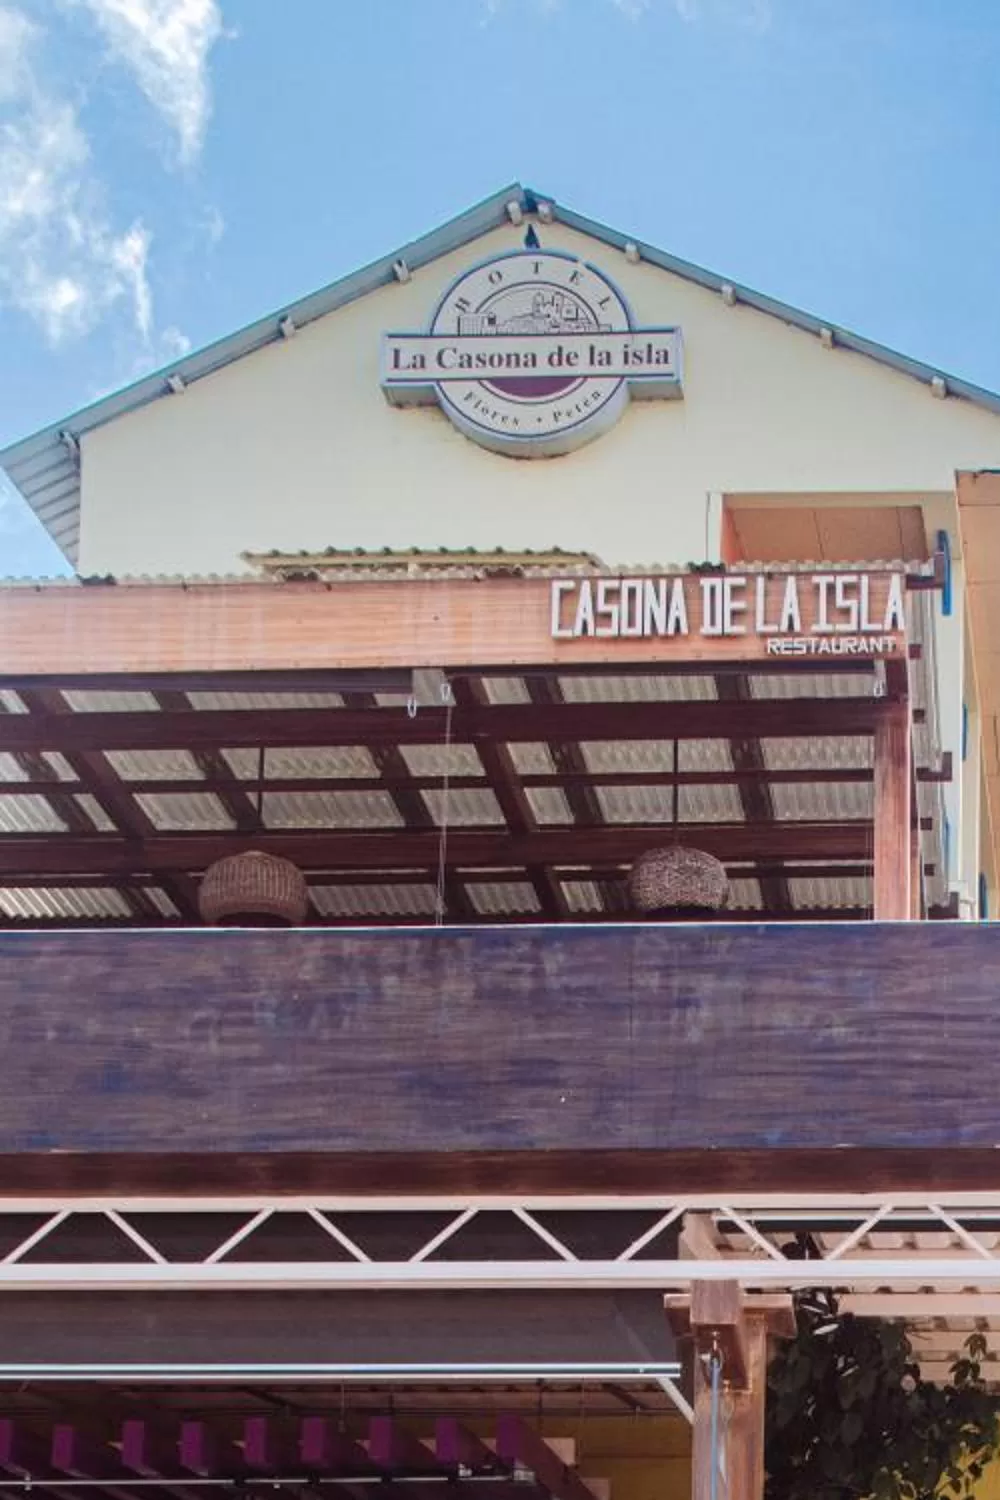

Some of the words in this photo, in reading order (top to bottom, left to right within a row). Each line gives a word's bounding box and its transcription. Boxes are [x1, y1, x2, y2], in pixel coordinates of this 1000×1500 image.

[455, 260, 611, 313] HOTEL
[391, 347, 426, 371] La
[435, 346, 537, 370] Casona
[547, 344, 580, 368] de
[588, 343, 613, 367] la
[622, 343, 671, 366] isla
[463, 391, 521, 427] Flores
[551, 578, 689, 637] CASONA
[700, 576, 747, 635] DE
[755, 576, 801, 633] LA
[810, 574, 905, 632] ISLA
[767, 635, 897, 655] RESTAURANT
